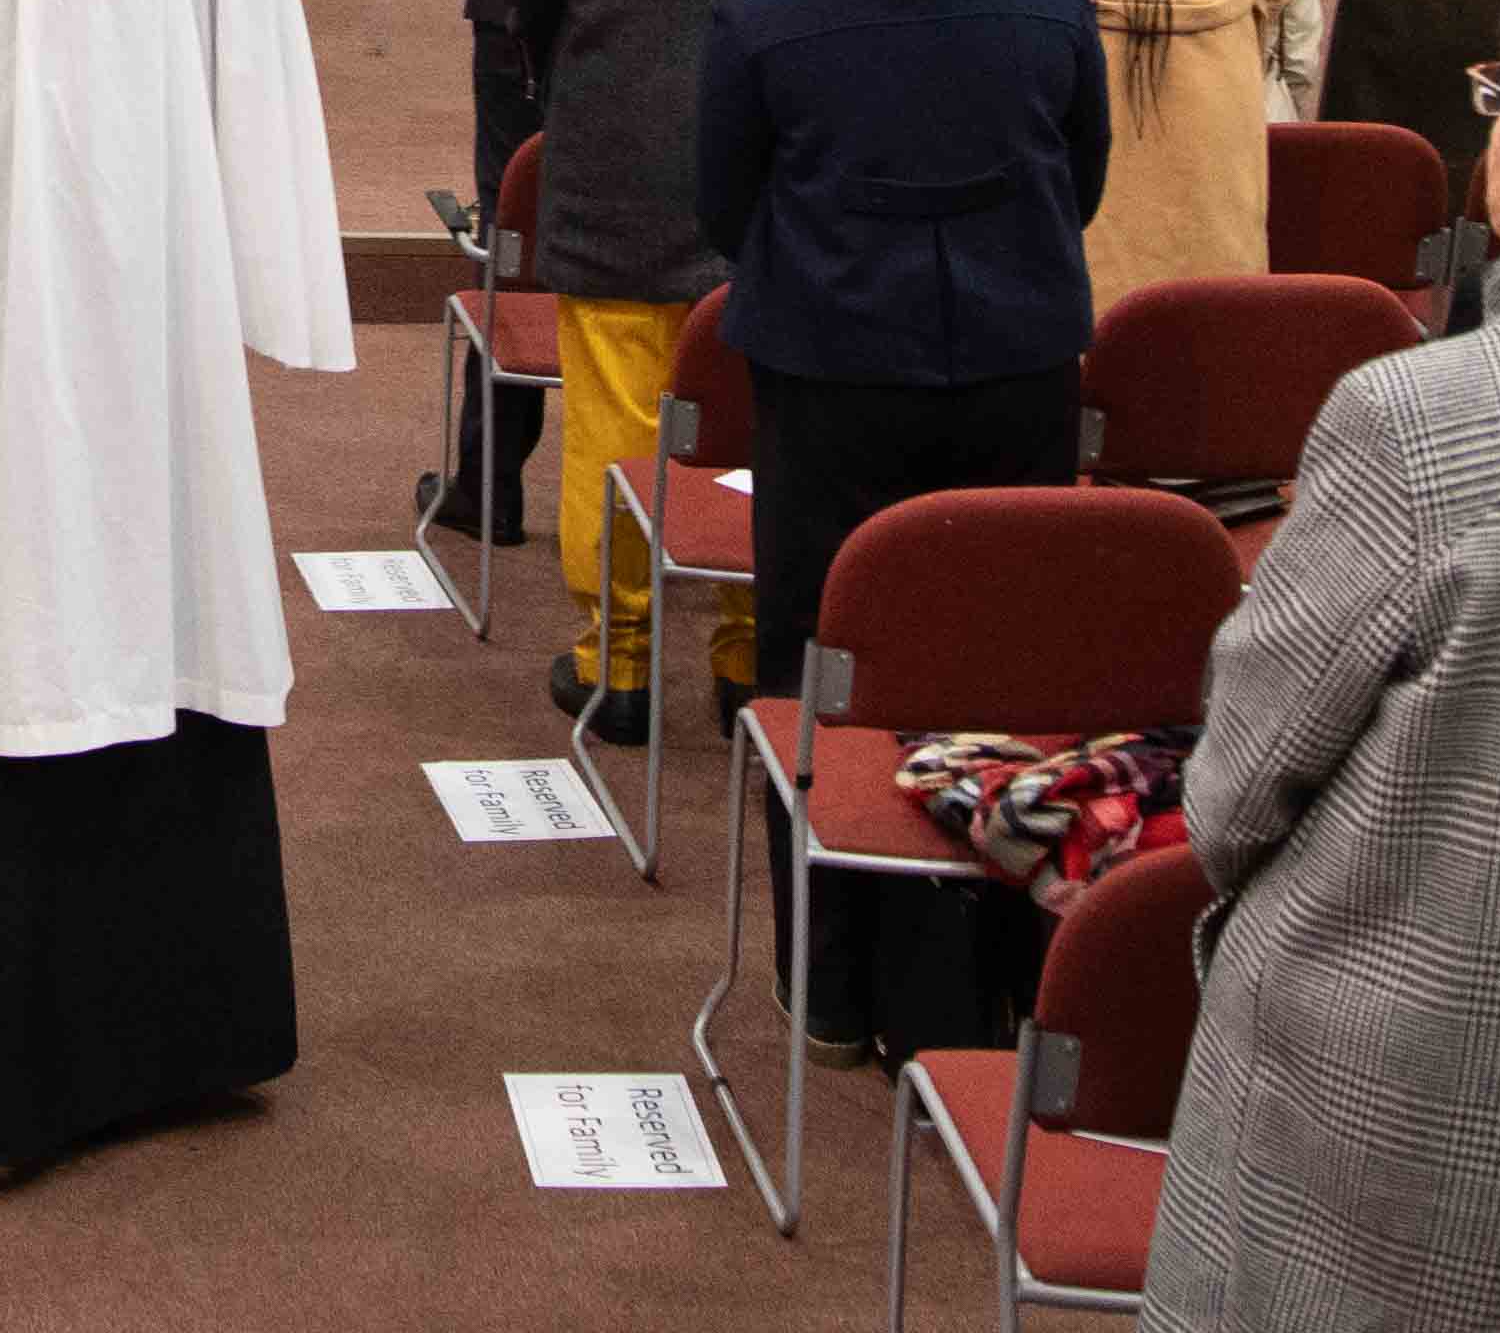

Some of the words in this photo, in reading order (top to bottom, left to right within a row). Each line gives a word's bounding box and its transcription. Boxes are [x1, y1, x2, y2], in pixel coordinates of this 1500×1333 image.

[463, 768, 494, 789] for
[520, 769, 586, 831] Reserved
[475, 791, 527, 835] Family
[555, 1084, 593, 1110] for
[566, 1117, 620, 1179] Family
[627, 1087, 694, 1174] Reserved
